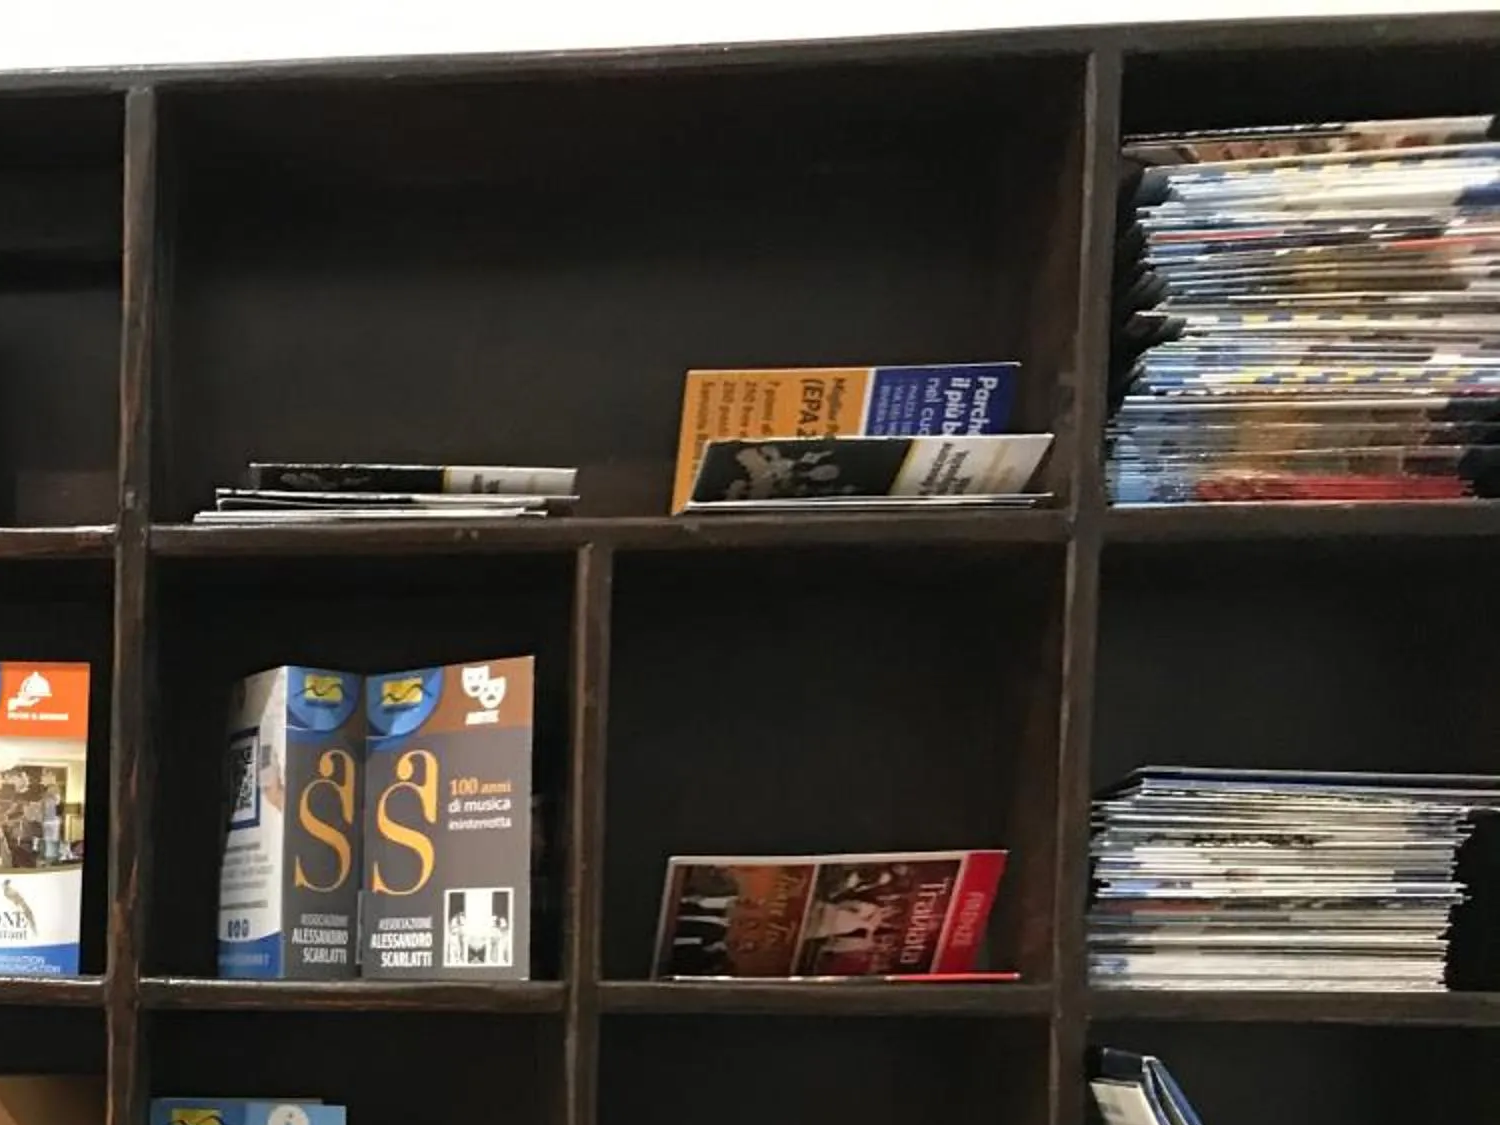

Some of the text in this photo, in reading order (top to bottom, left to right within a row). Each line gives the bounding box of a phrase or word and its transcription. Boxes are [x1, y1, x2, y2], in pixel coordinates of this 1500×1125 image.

[450, 778, 511, 797] 100 anni
[448, 797, 511, 814] di musica
[291, 926, 348, 946] ALESSANDRO
[370, 930, 433, 950] ALESSANDRO
[302, 947, 347, 964] SCARLATTI
[380, 949, 433, 968] SCARLATTI
